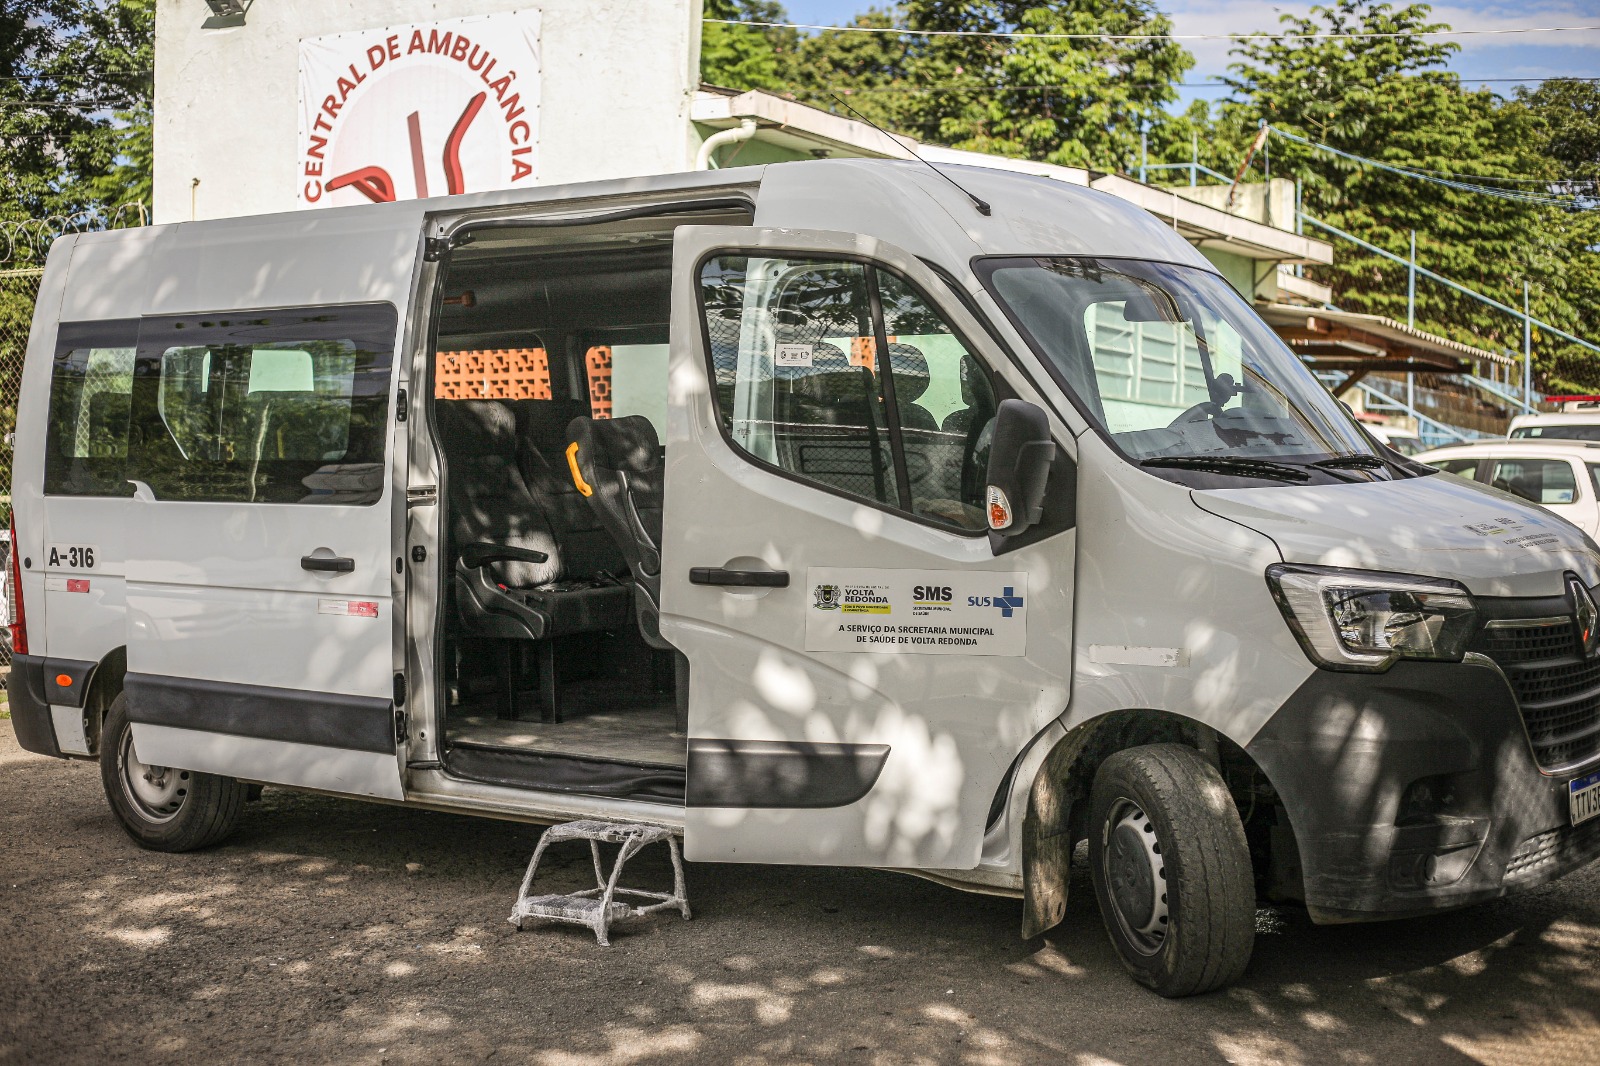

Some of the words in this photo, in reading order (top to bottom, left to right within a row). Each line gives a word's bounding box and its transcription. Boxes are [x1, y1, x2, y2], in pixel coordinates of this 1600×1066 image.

[304, 64, 367, 203] CENTRAL
[366, 34, 401, 71] DE
[407, 28, 533, 182] AMBULÂNCIA
[49, 546, 94, 568] A-316
[912, 585, 953, 602] SMS
[967, 596, 991, 607] SUS
[838, 624, 845, 632] A
[846, 624, 882, 634] SERVIÇO
[883, 625, 896, 633] DA
[949, 627, 995, 635] MUNICIPAL
[856, 635, 867, 643] DE
[869, 634, 896, 644] SAÚDE
[898, 636, 909, 644] DE
[910, 636, 936, 645] VOLTA
[938, 637, 978, 646] REDONDA
